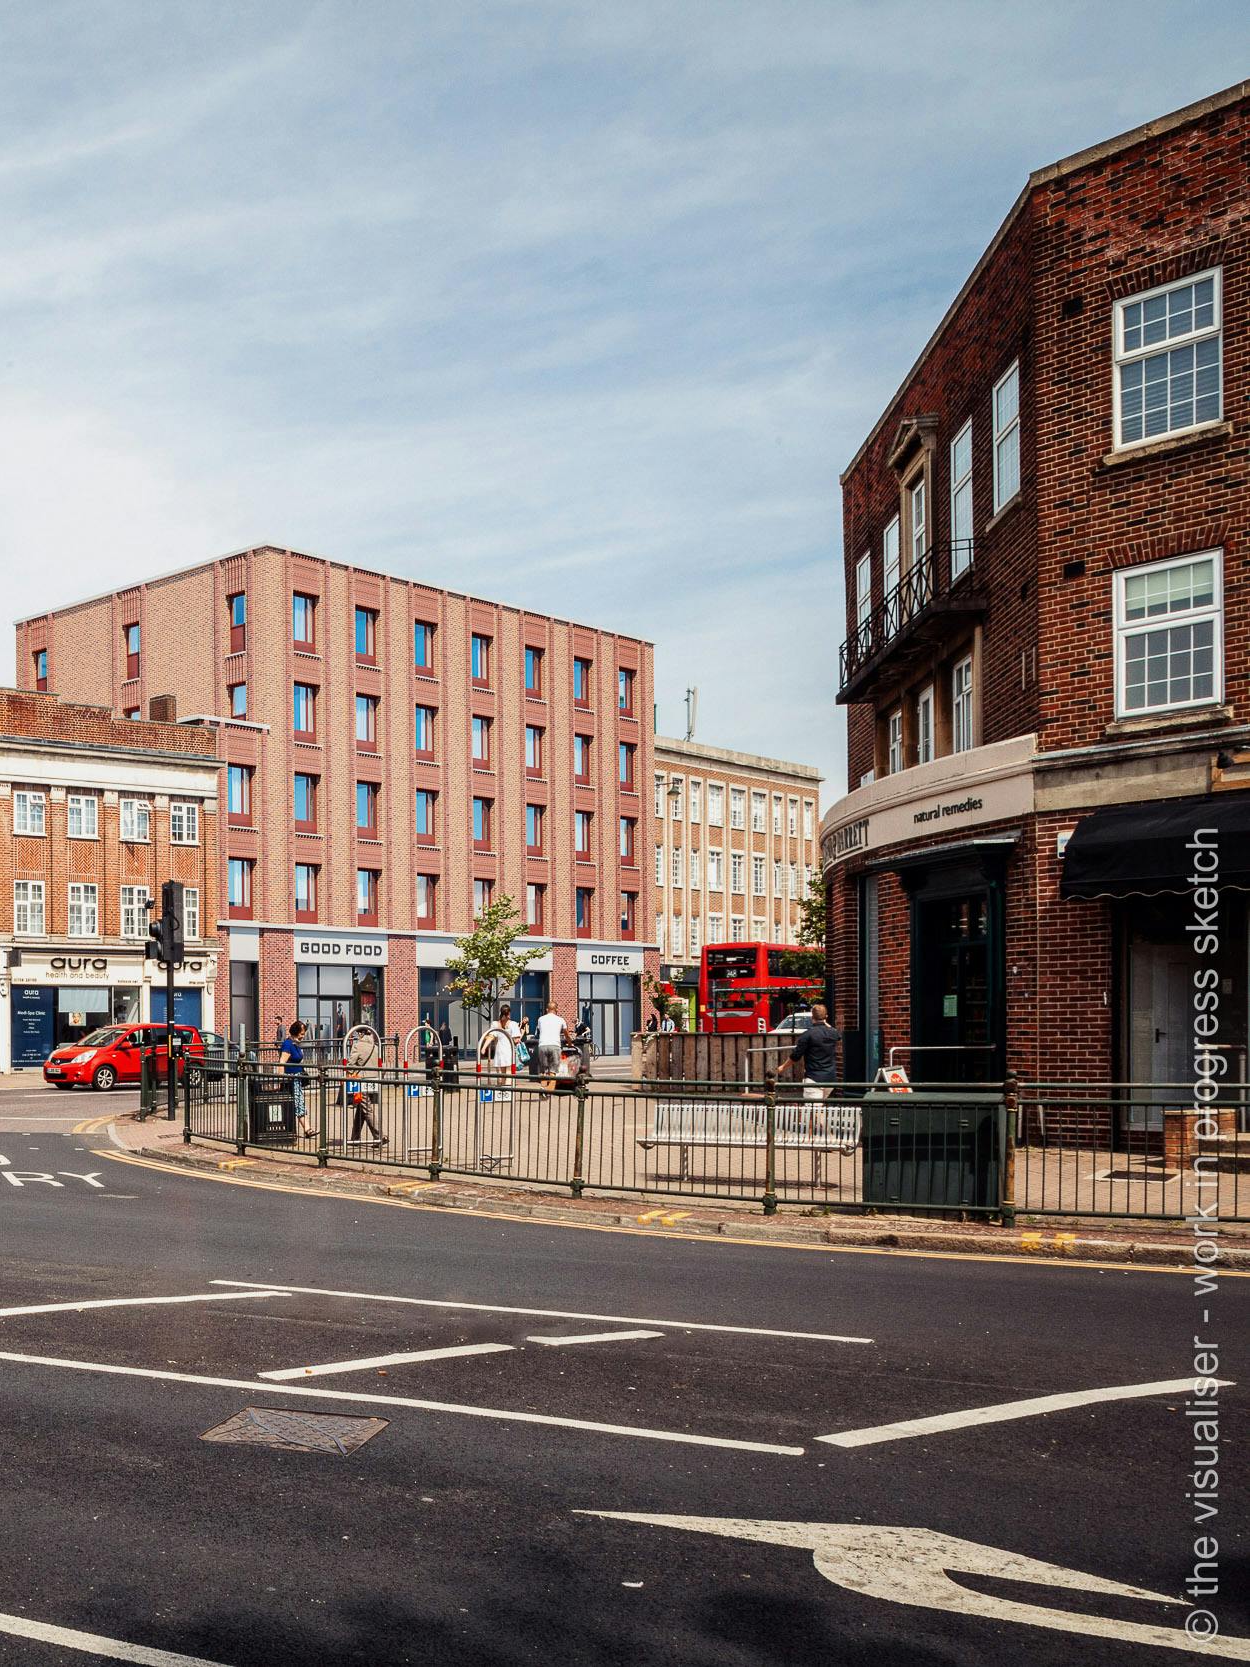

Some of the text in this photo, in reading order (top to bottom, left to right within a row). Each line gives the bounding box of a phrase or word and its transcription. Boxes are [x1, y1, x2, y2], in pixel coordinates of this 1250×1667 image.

[913, 797, 983, 824] natural remedies
[300, 942, 383, 957] GOOD FOOD
[50, 957, 108, 970] aura
[591, 954, 630, 966] COFFEE
[45, 971, 110, 980] health and beauty
